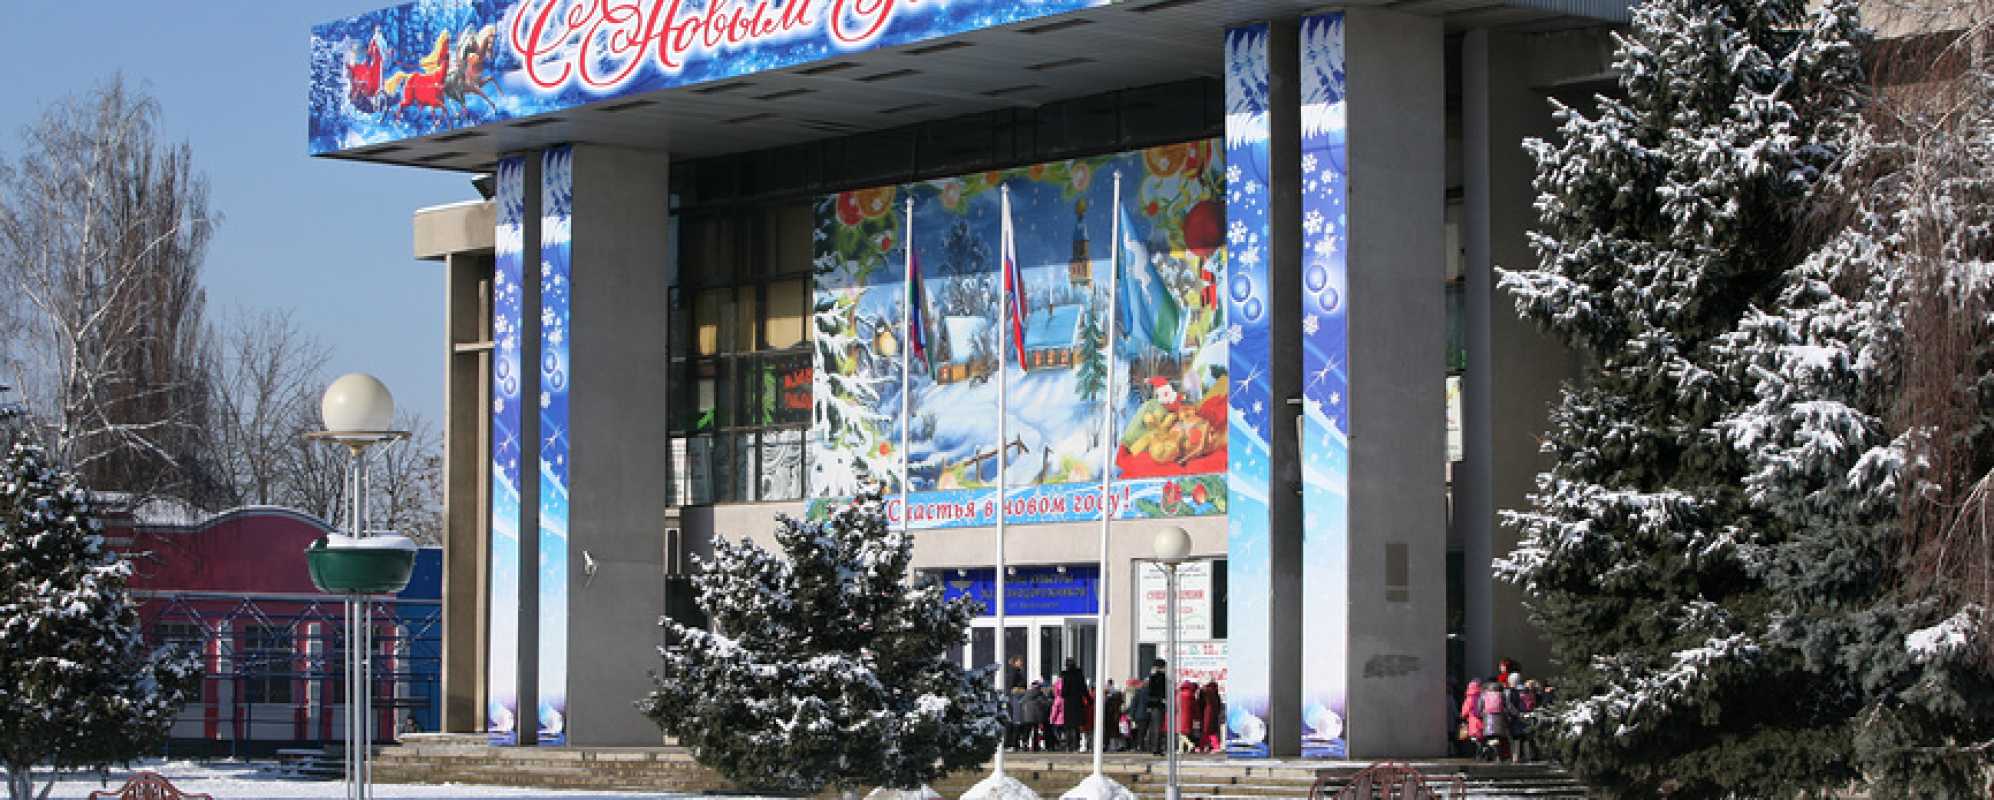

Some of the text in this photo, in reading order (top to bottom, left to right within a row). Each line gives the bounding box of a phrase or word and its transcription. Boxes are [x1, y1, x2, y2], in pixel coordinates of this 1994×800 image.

[512, 0, 597, 88] С
[580, 0, 812, 86] Новым
[985, 499, 993, 517] в
